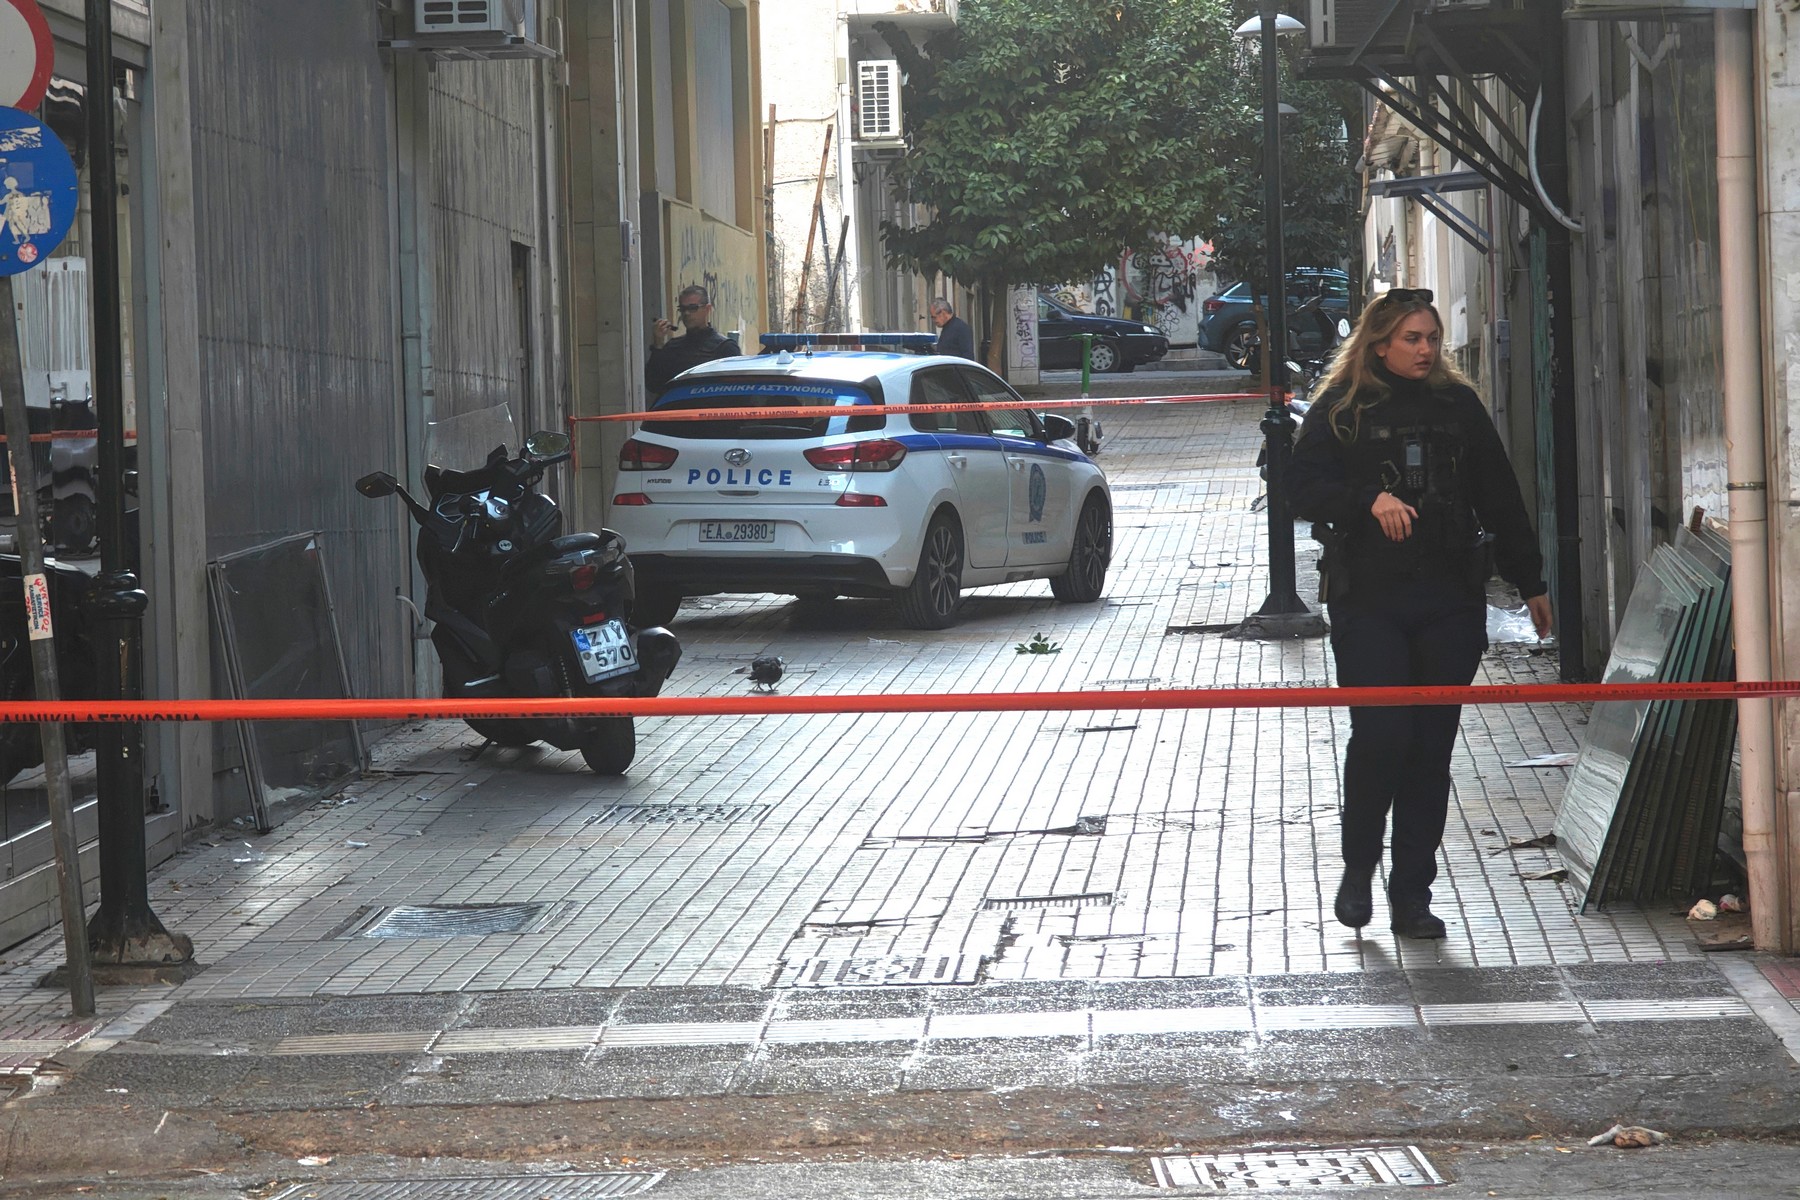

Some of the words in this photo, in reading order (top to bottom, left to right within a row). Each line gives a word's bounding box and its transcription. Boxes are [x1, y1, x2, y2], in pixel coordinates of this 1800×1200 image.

[690, 384, 755, 395] ΕΛΛΗΝΙΚΗ
[759, 384, 834, 395] ΑΣΤΥΝΟΜΙΑ
[687, 468, 793, 486] POLICE
[733, 524, 768, 540] 29380
[587, 624, 623, 647] ZIY
[594, 645, 631, 667] 570
